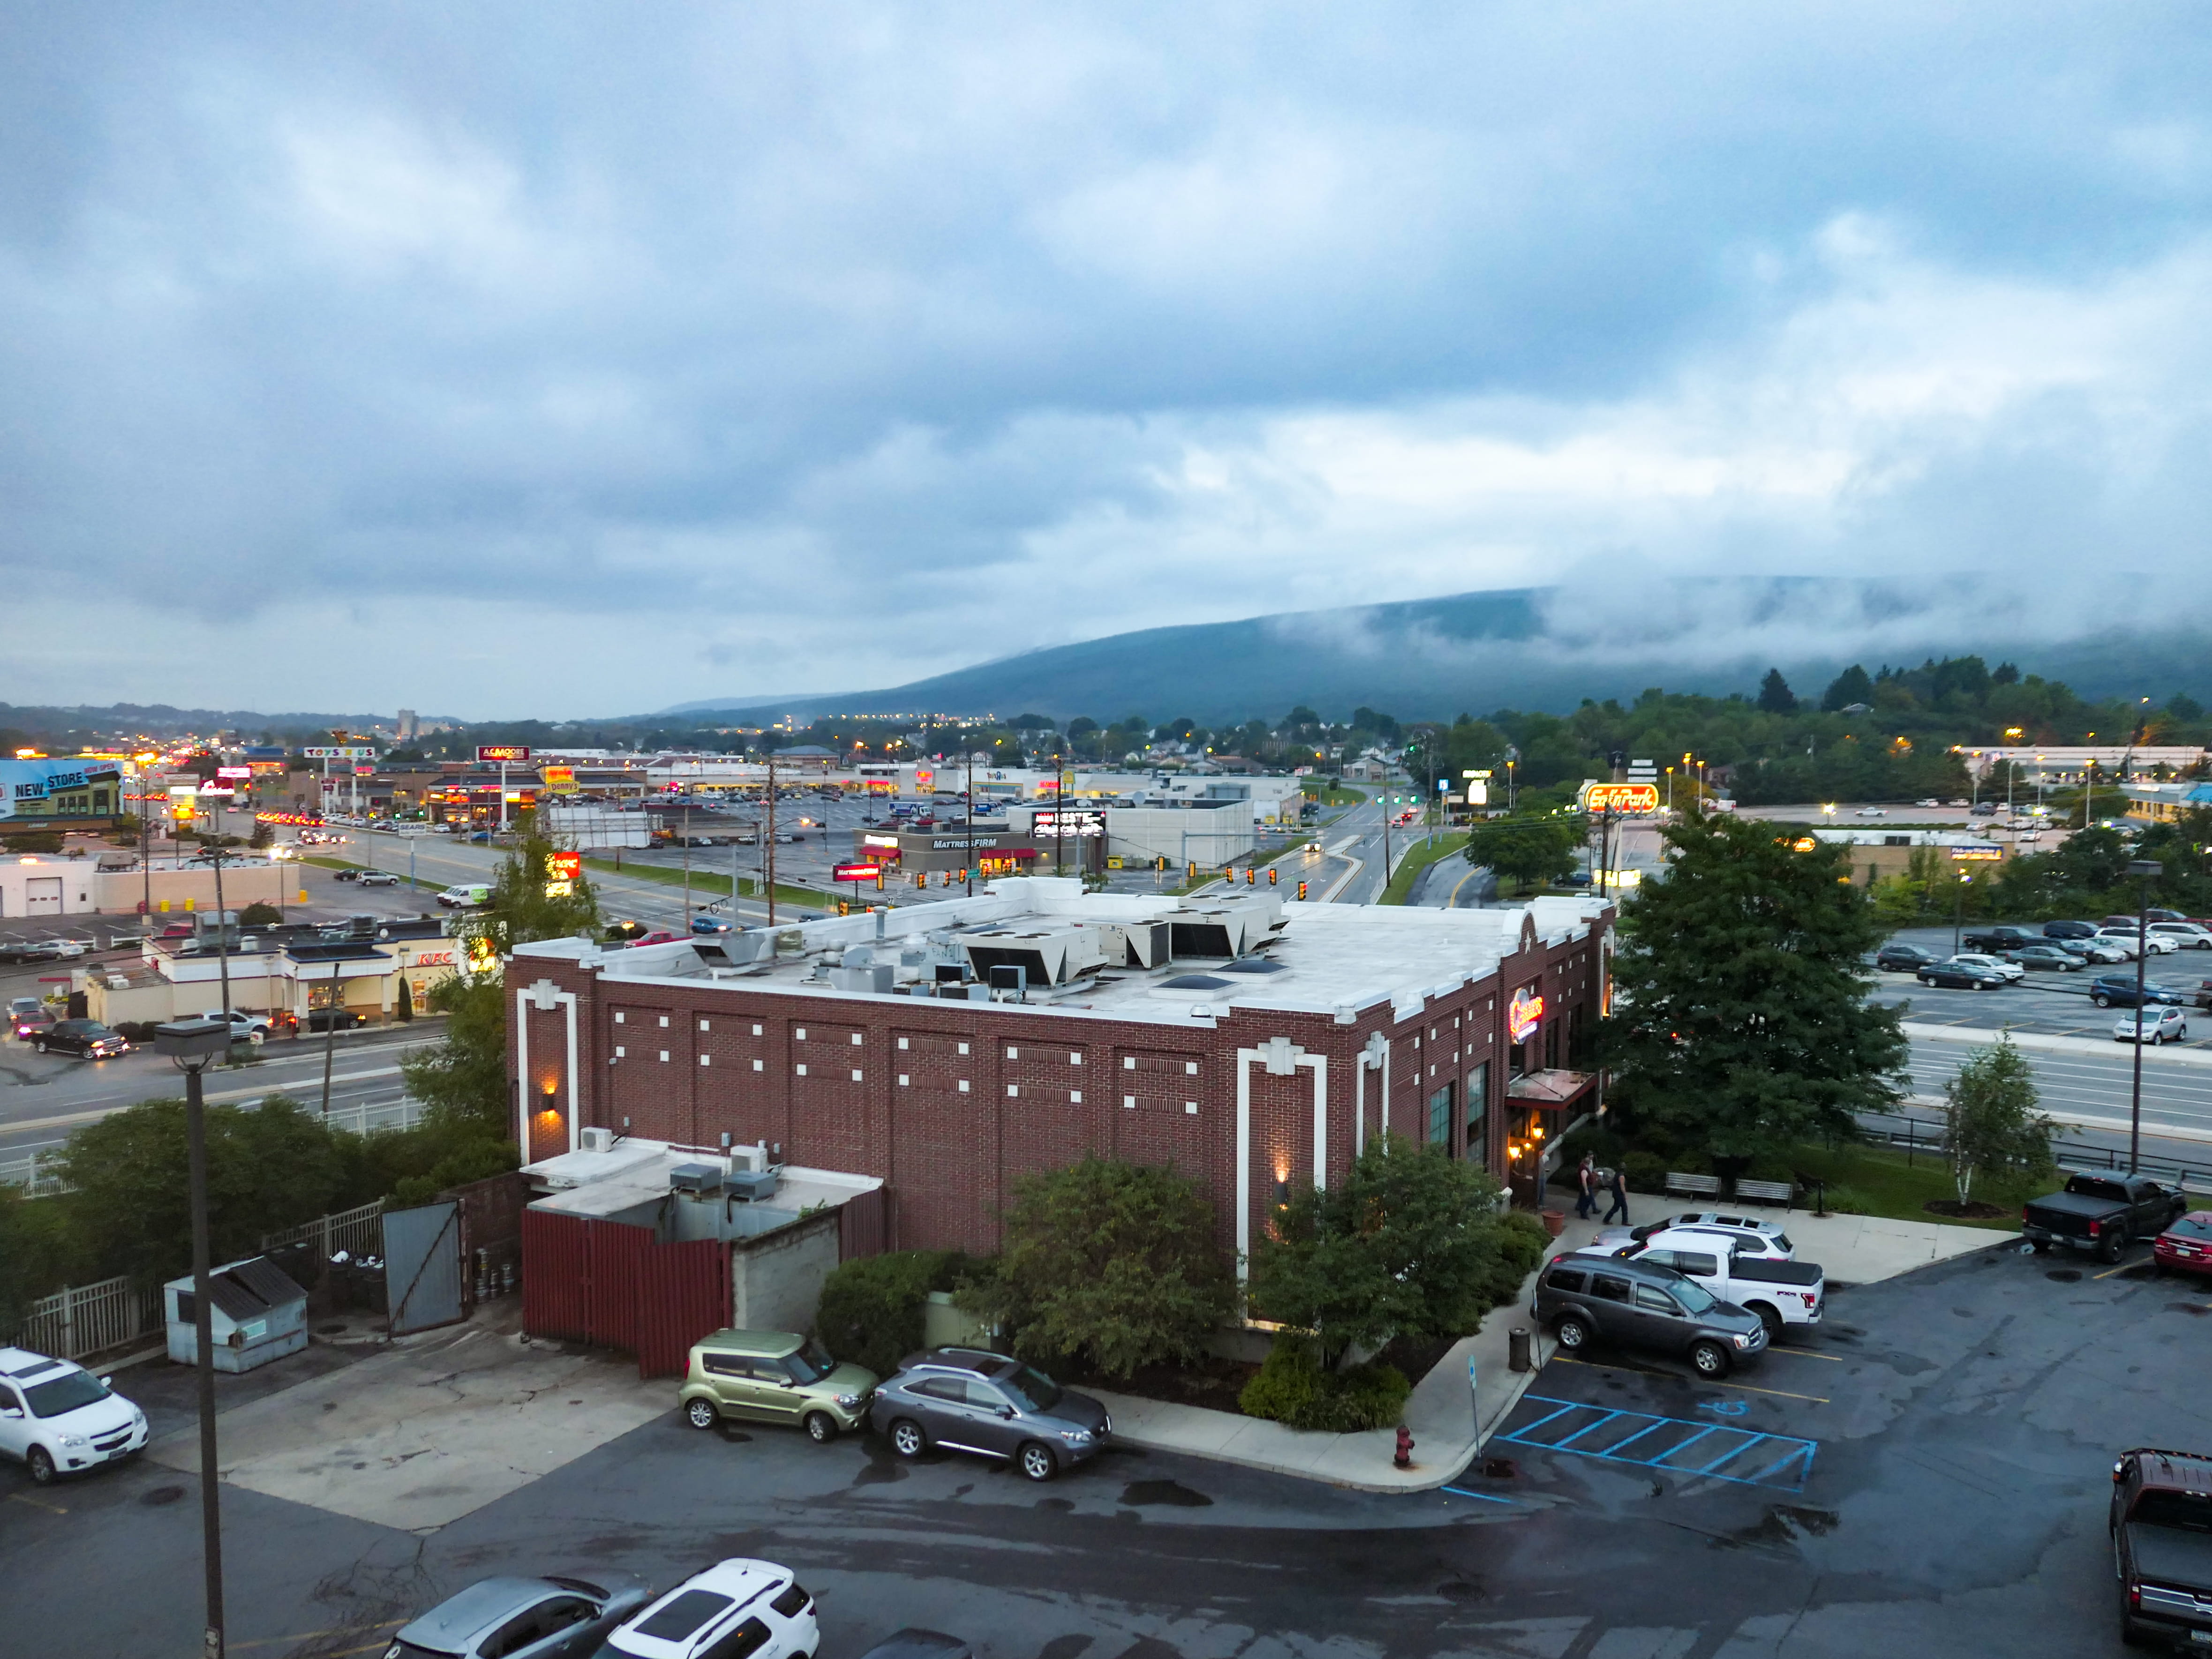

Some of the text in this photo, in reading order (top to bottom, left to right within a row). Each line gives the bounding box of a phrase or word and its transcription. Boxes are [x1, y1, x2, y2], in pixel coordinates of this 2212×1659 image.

[99, 763, 115, 772] OPEN
[15, 783, 44, 797] NEW
[48, 773, 83, 788] STORE
[1117, 928, 1123, 939] 3
[417, 952, 452, 965] KFC
